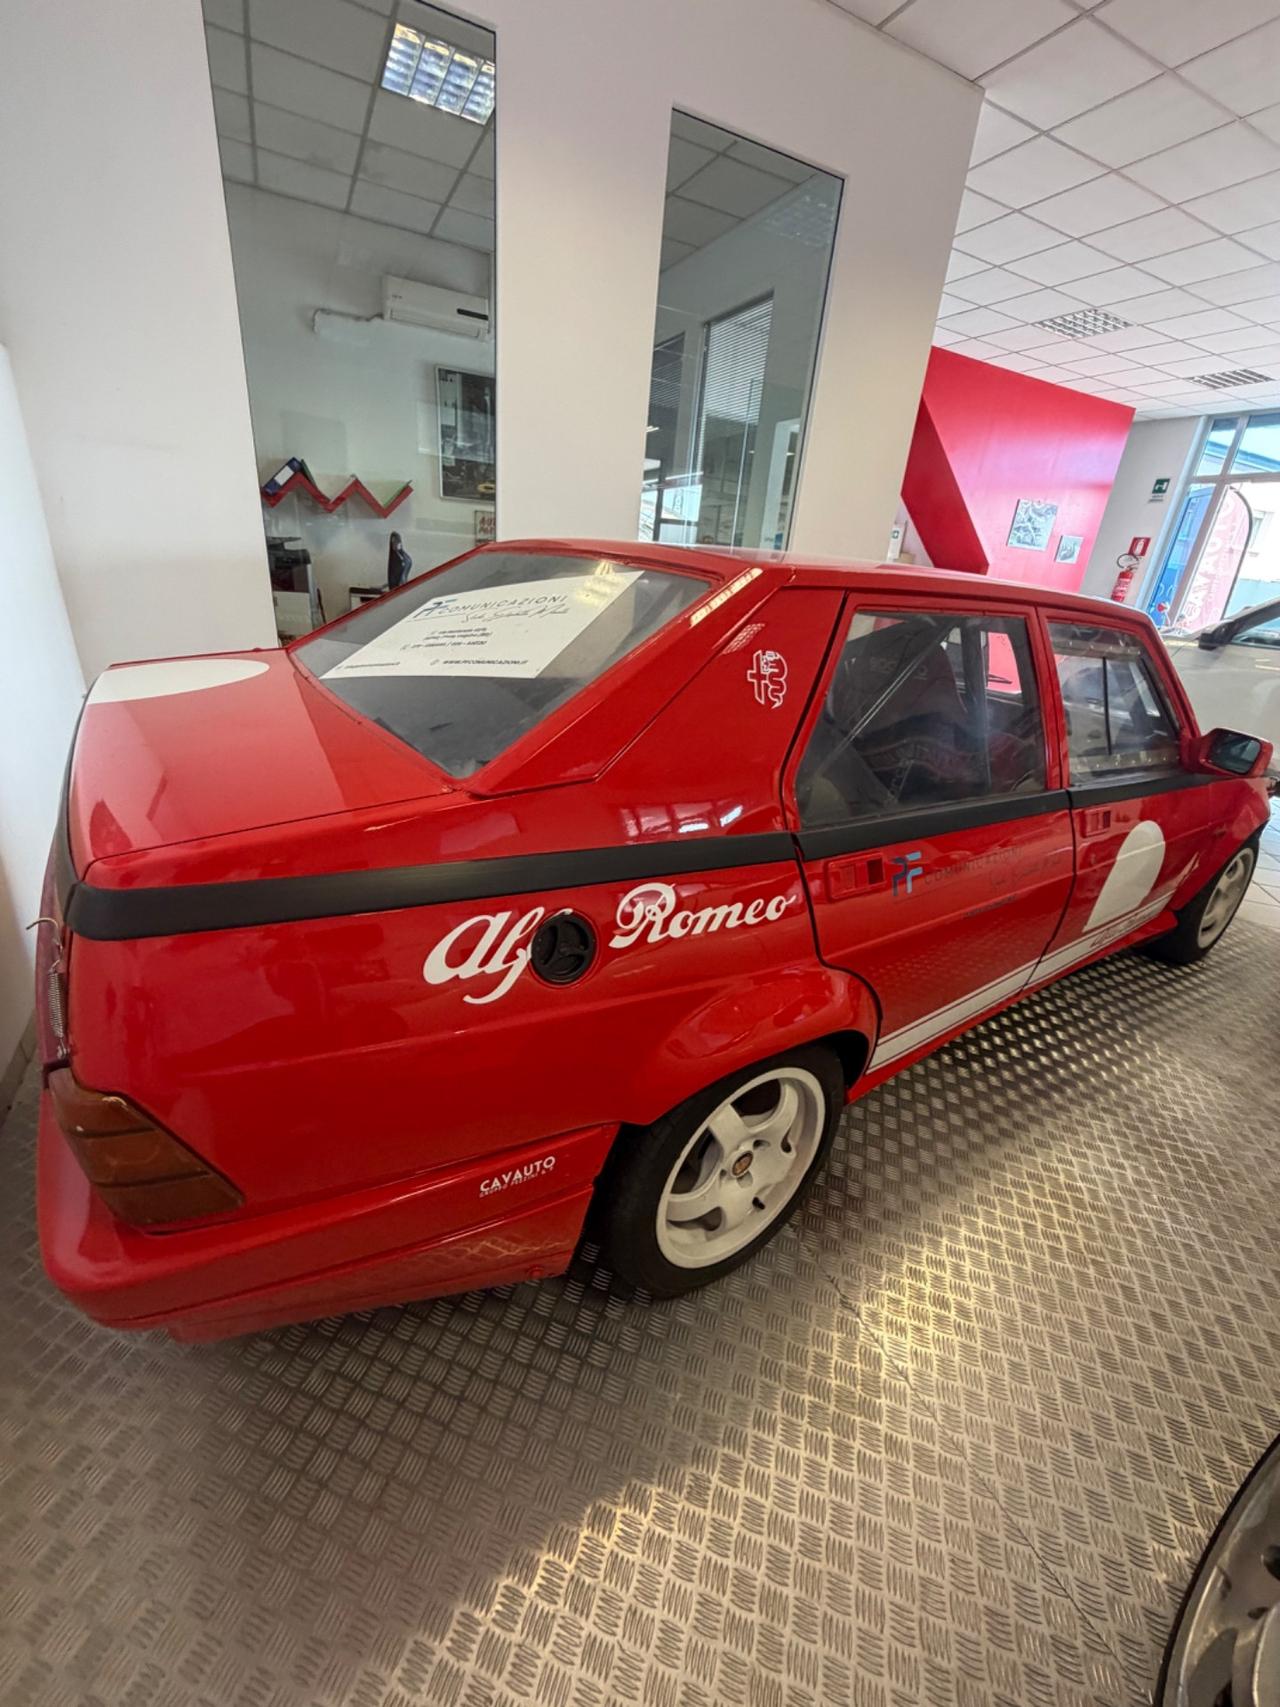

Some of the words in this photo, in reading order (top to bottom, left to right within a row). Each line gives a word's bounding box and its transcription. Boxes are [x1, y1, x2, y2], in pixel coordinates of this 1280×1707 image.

[438, 595, 568, 615] COMUNICAZIONI
[423, 906, 546, 1005] Alf
[608, 882, 798, 950] Romeo
[479, 1155, 556, 1193] CAVAUTO
